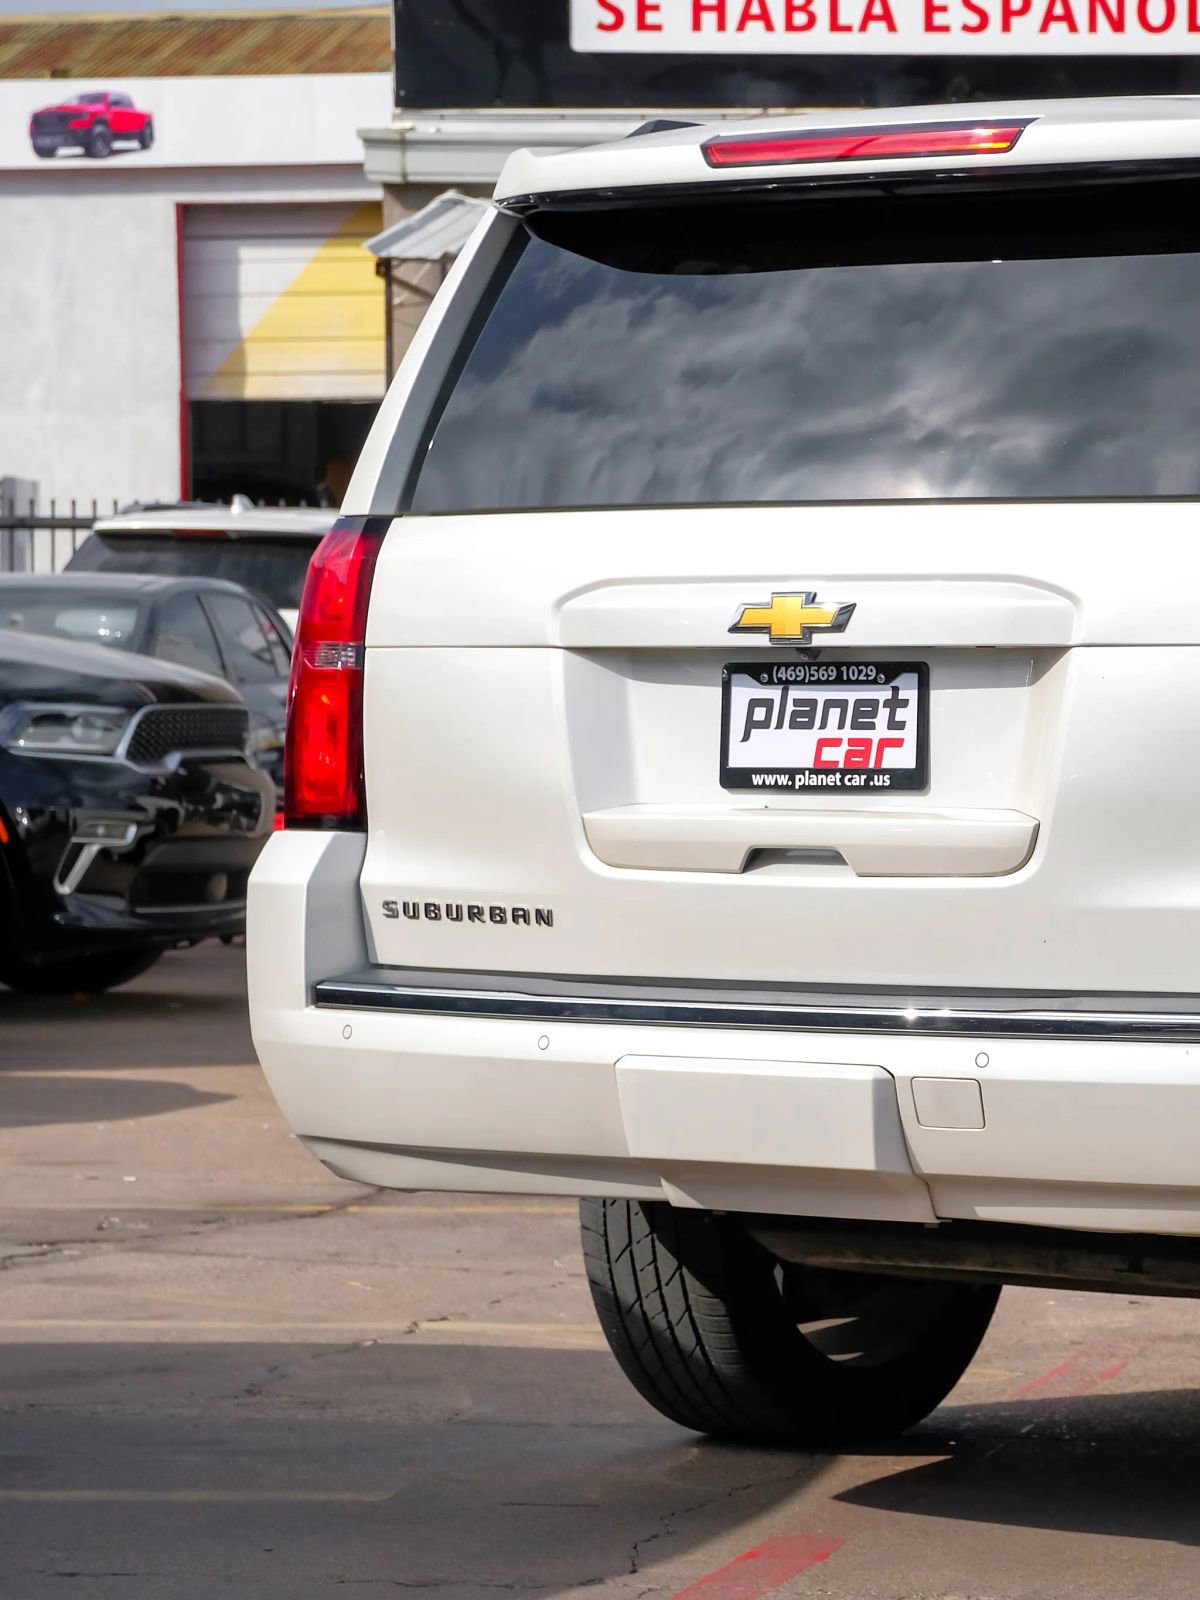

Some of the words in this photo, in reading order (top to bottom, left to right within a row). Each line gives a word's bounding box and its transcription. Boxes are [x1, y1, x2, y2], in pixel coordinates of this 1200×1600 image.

[595, 0, 663, 32] SE
[691, 0, 898, 33] HABLA
[772, 665, 837, 683] (469)569
[841, 665, 877, 681] 1029
[740, 685, 910, 743] planet
[813, 737, 905, 769] car
[381, 900, 554, 927] SUBURBAN
